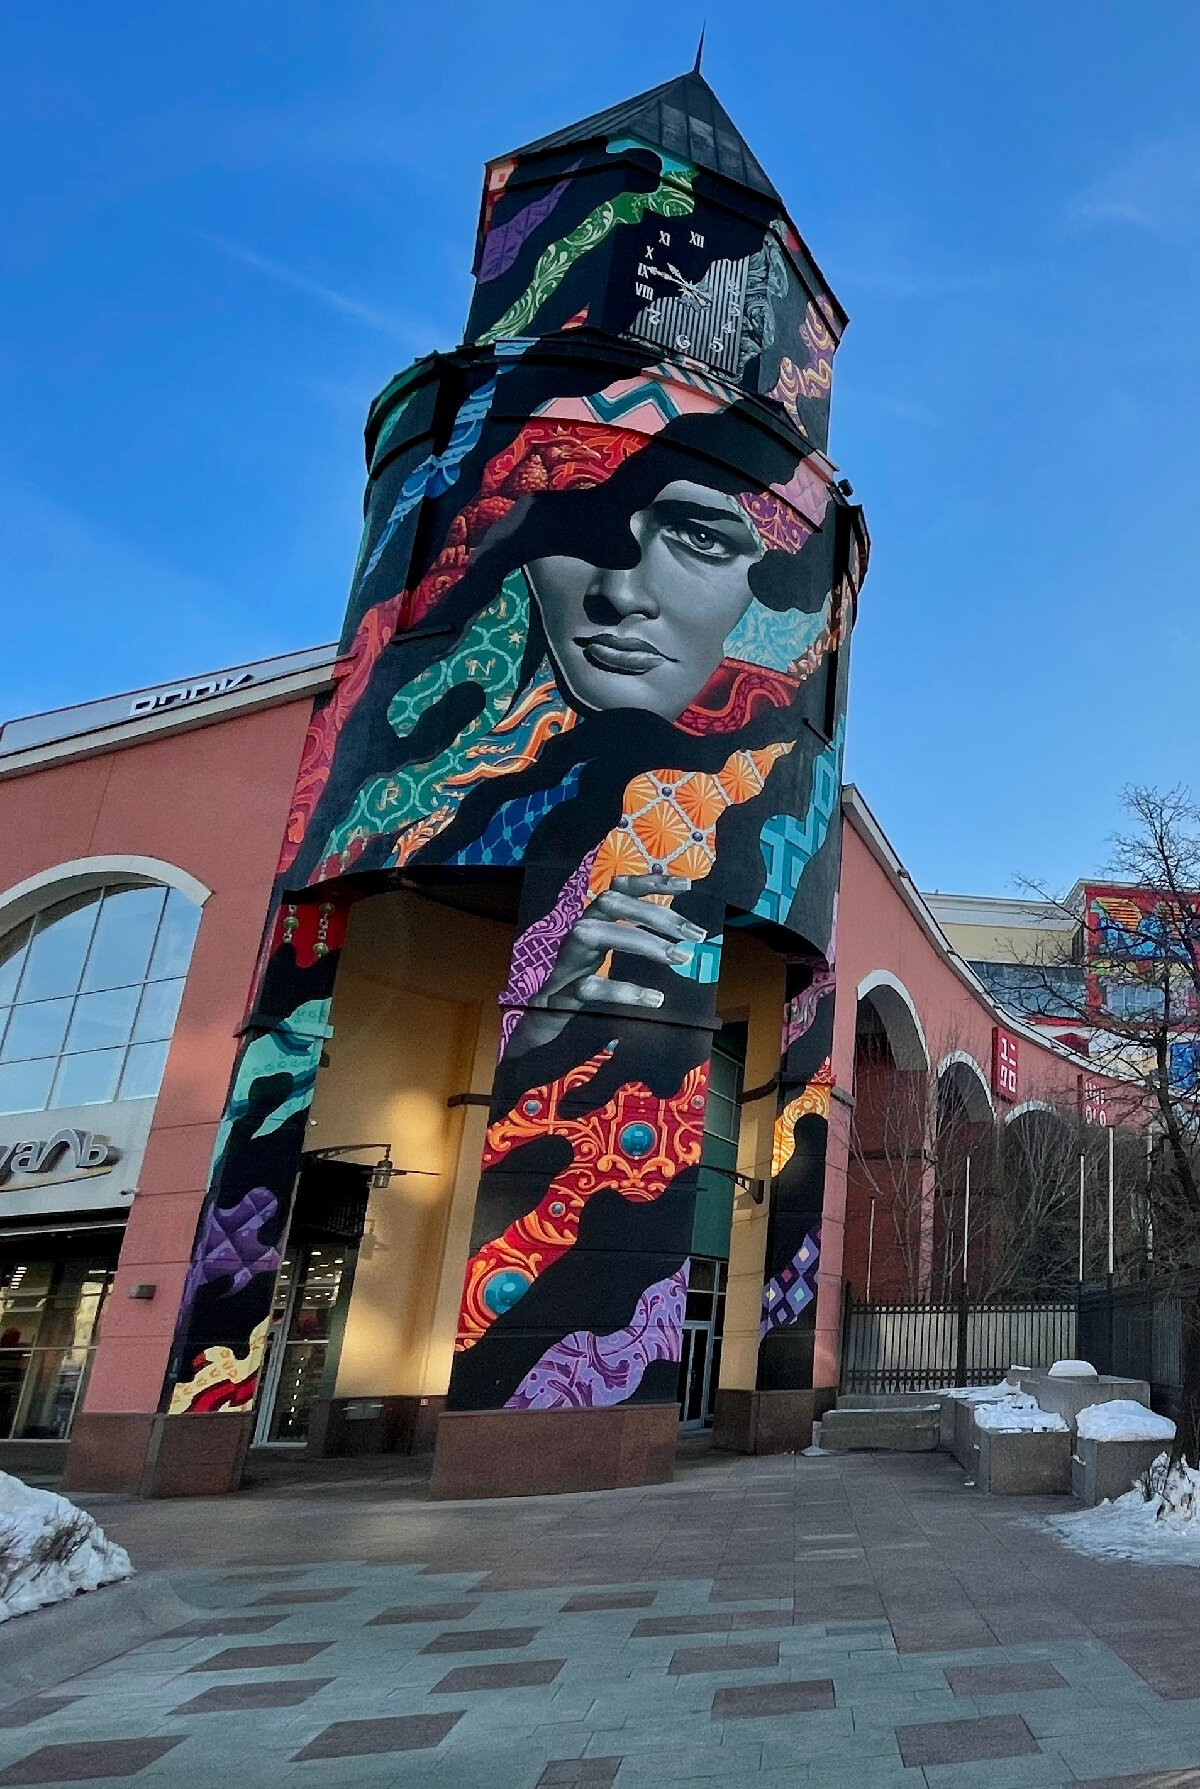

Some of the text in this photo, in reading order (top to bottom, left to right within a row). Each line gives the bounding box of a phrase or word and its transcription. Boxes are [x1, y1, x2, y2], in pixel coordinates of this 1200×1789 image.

[658, 230, 671, 247] XI
[689, 230, 705, 249] XII
[645, 245, 654, 260] X
[635, 281, 654, 301] VIII
[710, 336, 724, 353] 5
